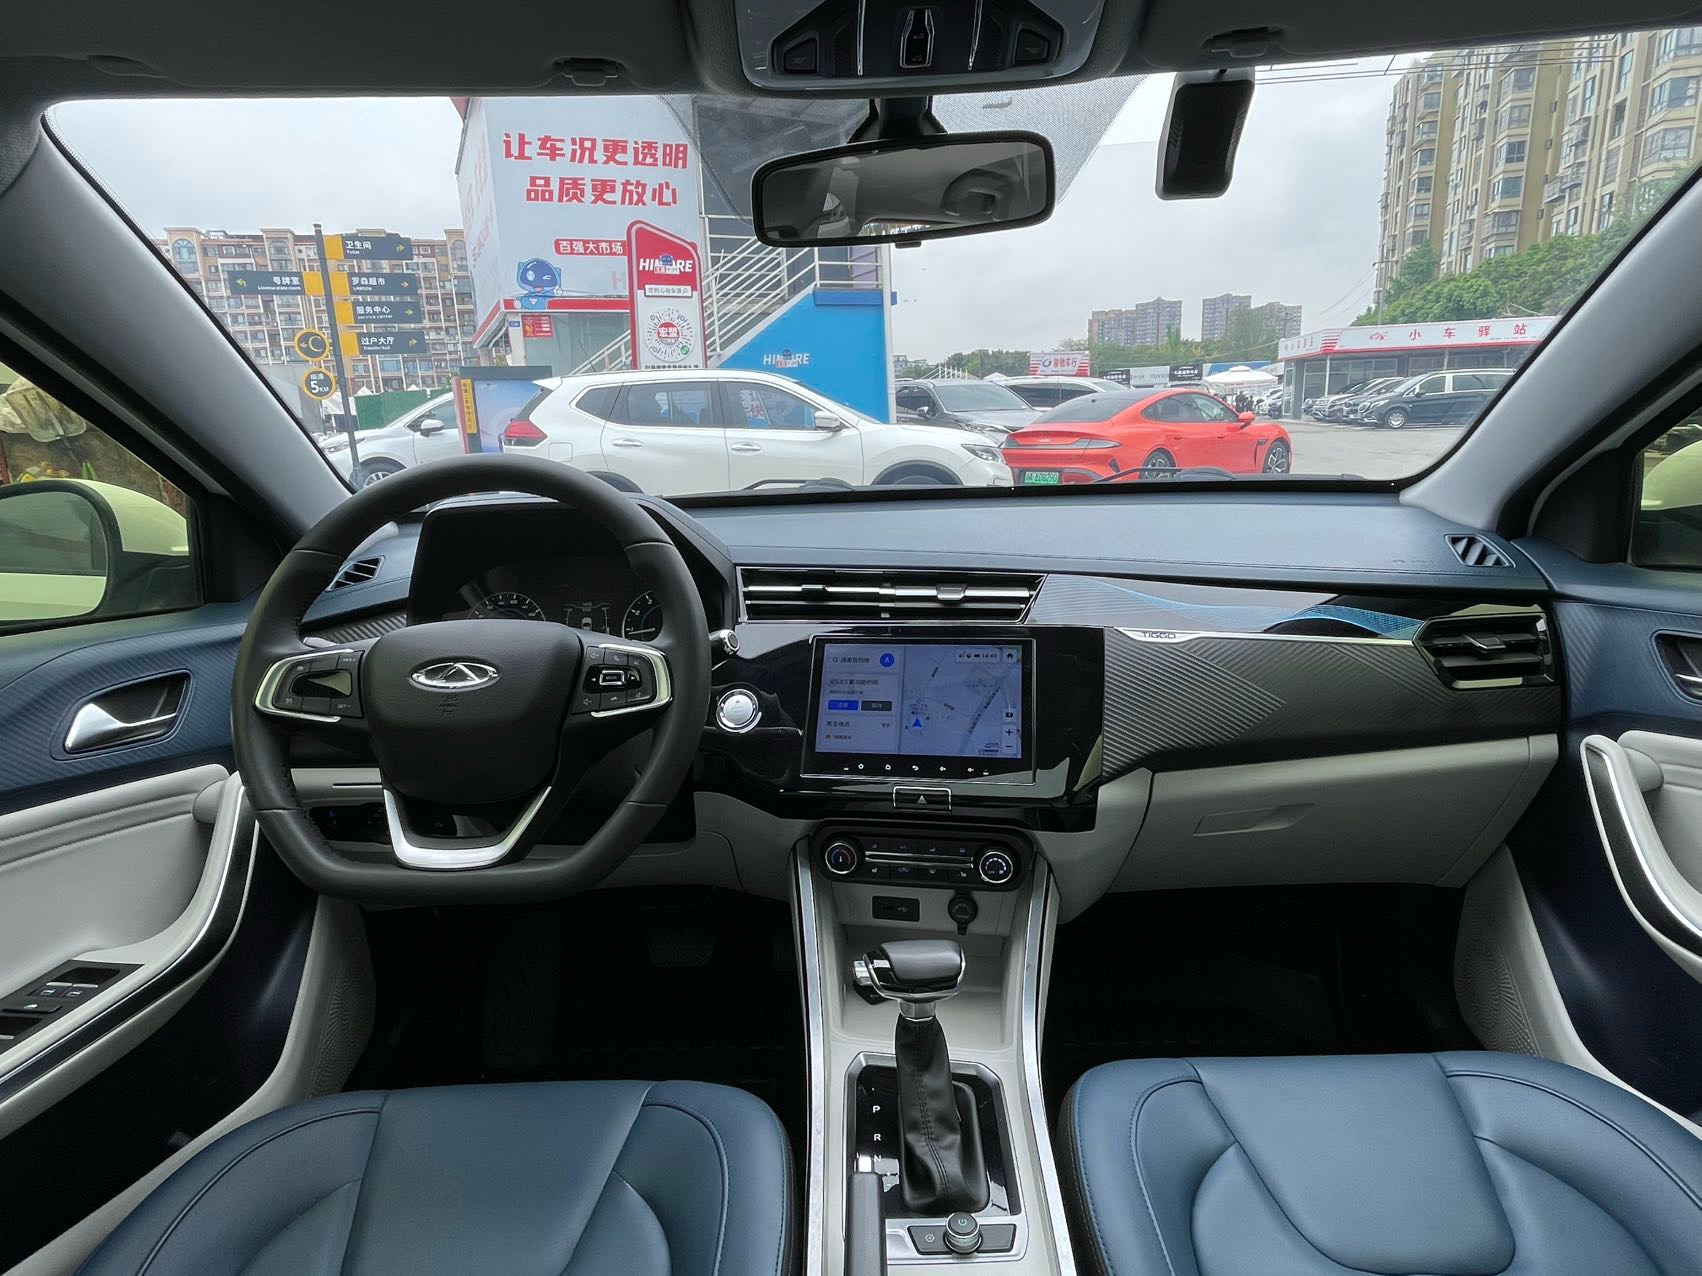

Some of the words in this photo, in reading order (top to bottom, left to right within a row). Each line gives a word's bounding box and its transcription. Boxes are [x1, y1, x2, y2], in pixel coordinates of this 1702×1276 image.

[503, 132, 688, 169] 让车况更透明
[525, 175, 678, 207] 品质更放心
[559, 240, 624, 255] 百强大市场
[351, 276, 385, 286] 罗森超市
[356, 306, 390, 315] 服务中心
[1408, 323, 1528, 341] 小车驿站
[361, 337, 394, 345] 过户大厅
[872, 1105, 880, 1114] P
[874, 1133, 882, 1142] R
